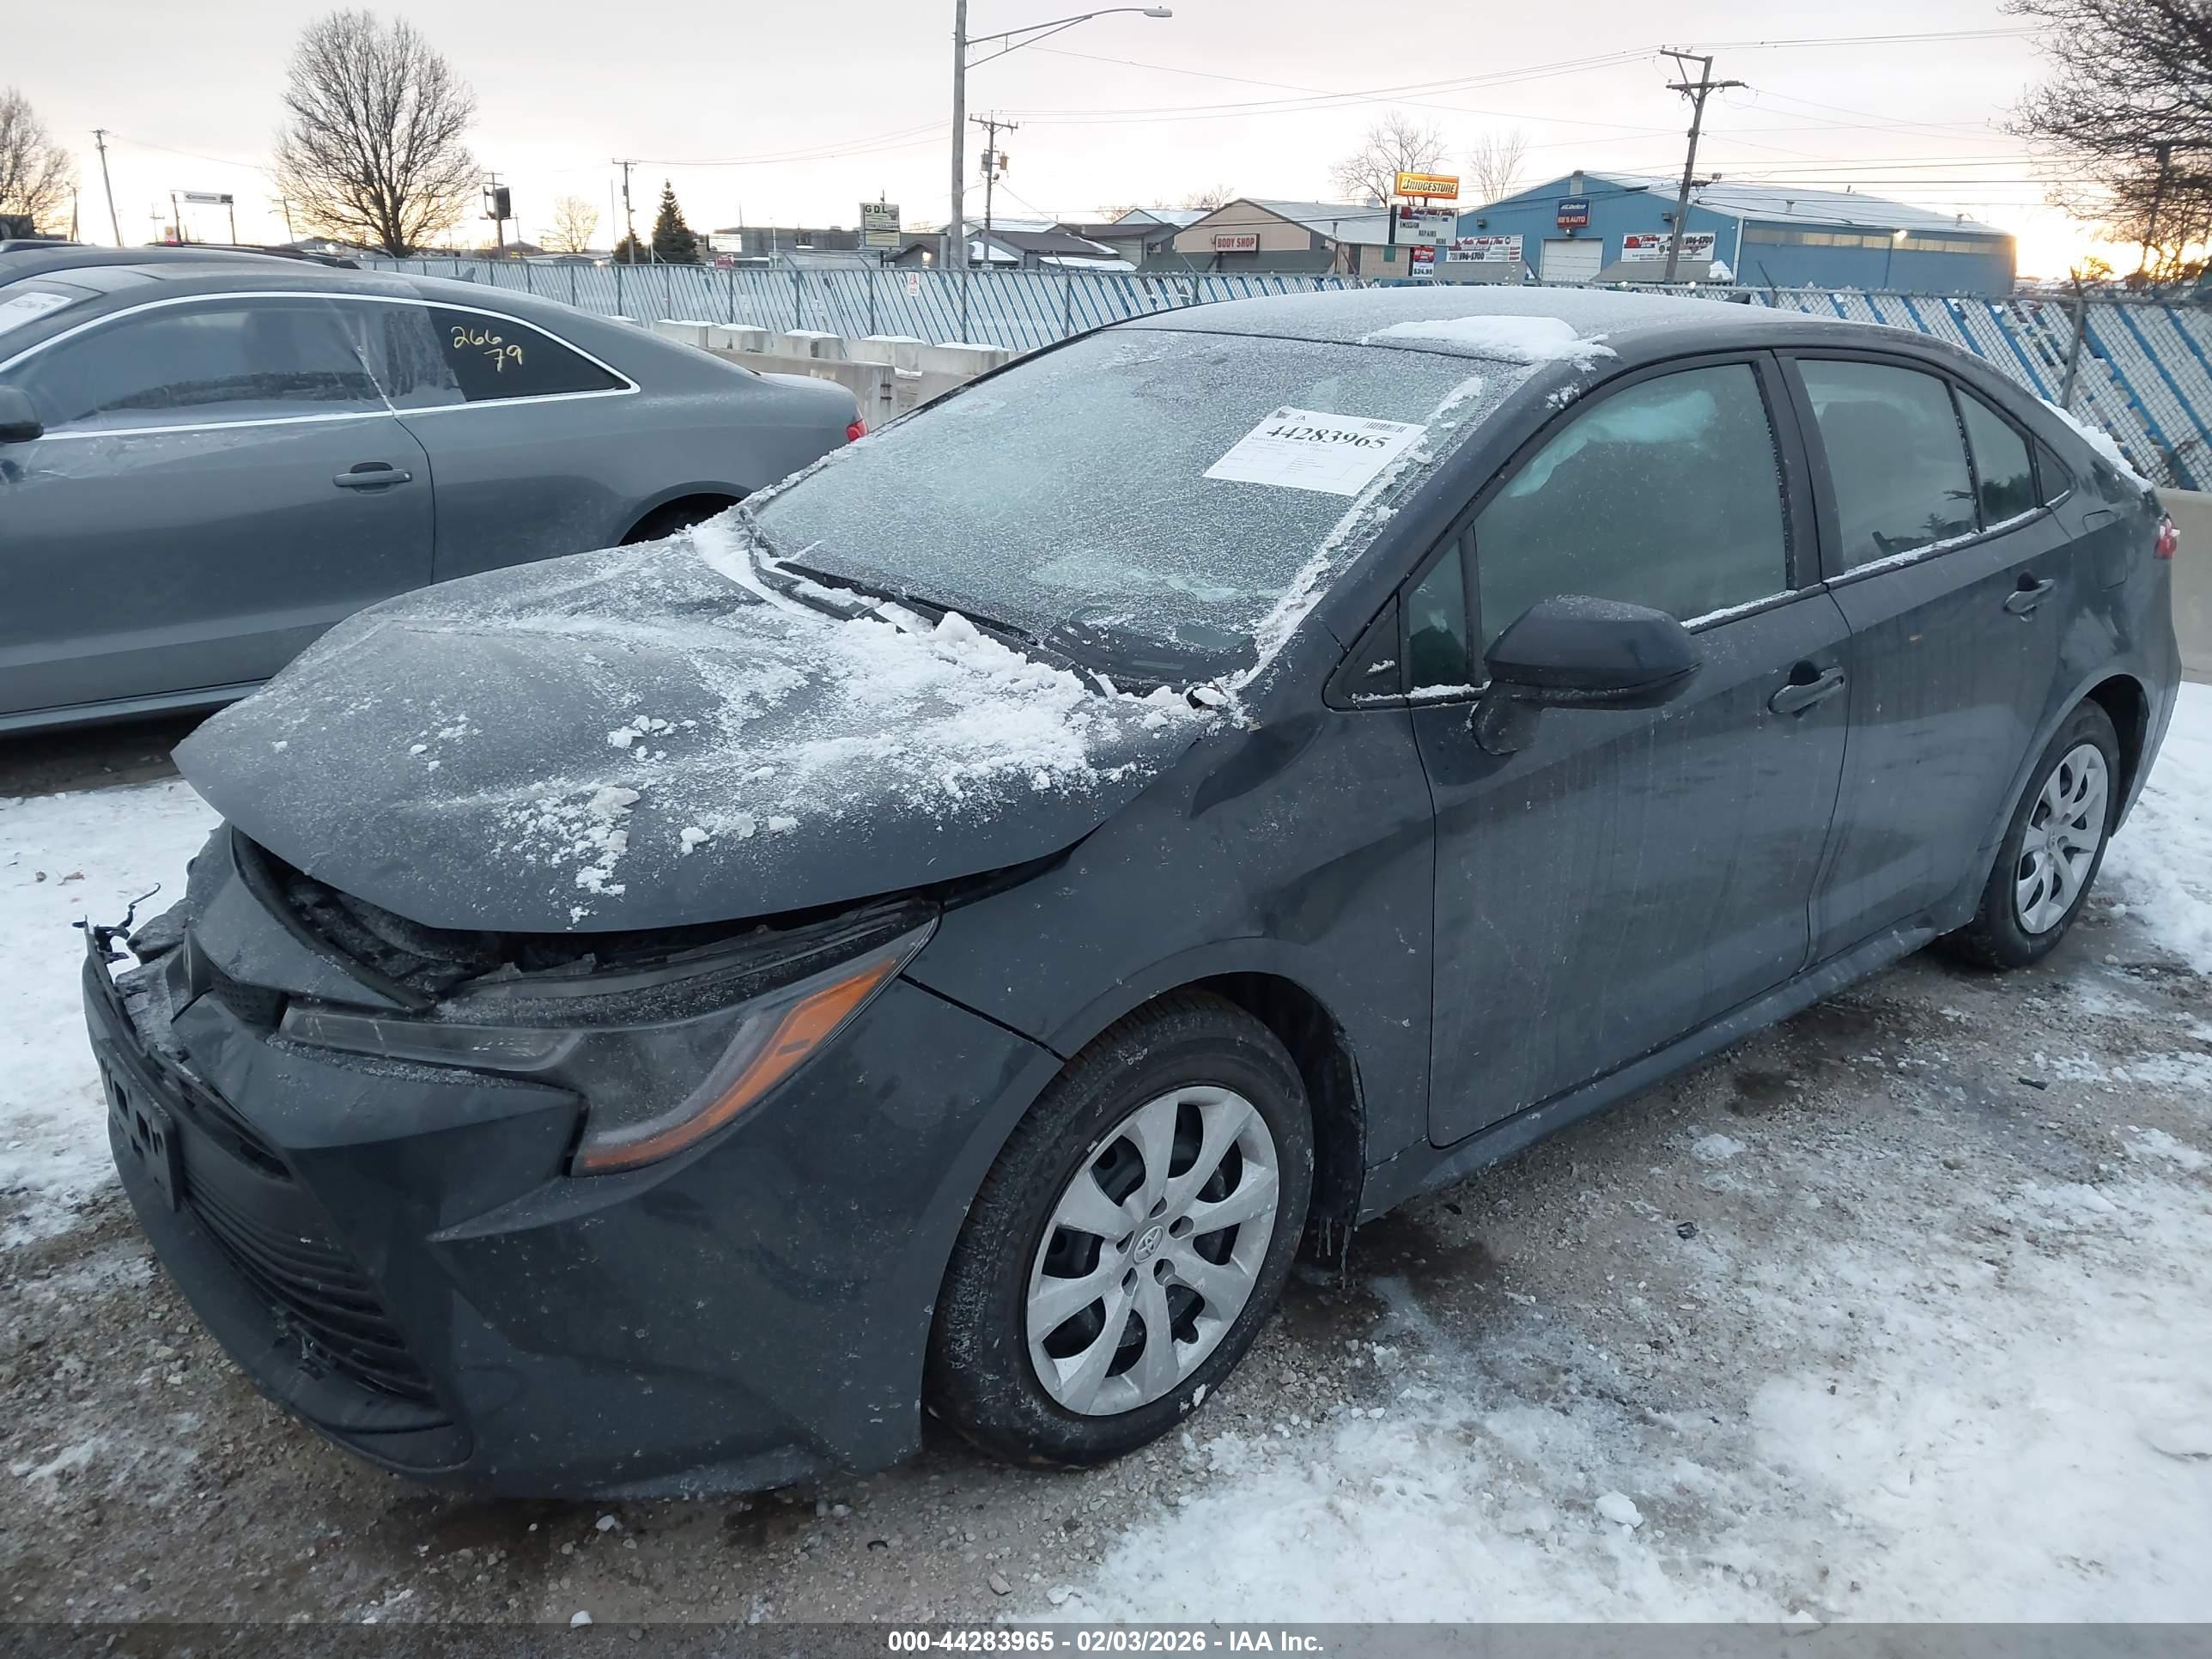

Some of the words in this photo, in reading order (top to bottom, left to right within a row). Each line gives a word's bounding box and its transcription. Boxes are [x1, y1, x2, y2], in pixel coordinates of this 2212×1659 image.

[1402, 177, 1455, 194] BRIDGESTONE
[1218, 238, 1236, 248] BODY
[1237, 237, 1255, 248] SHOP
[1266, 425, 1392, 450] 44283965
